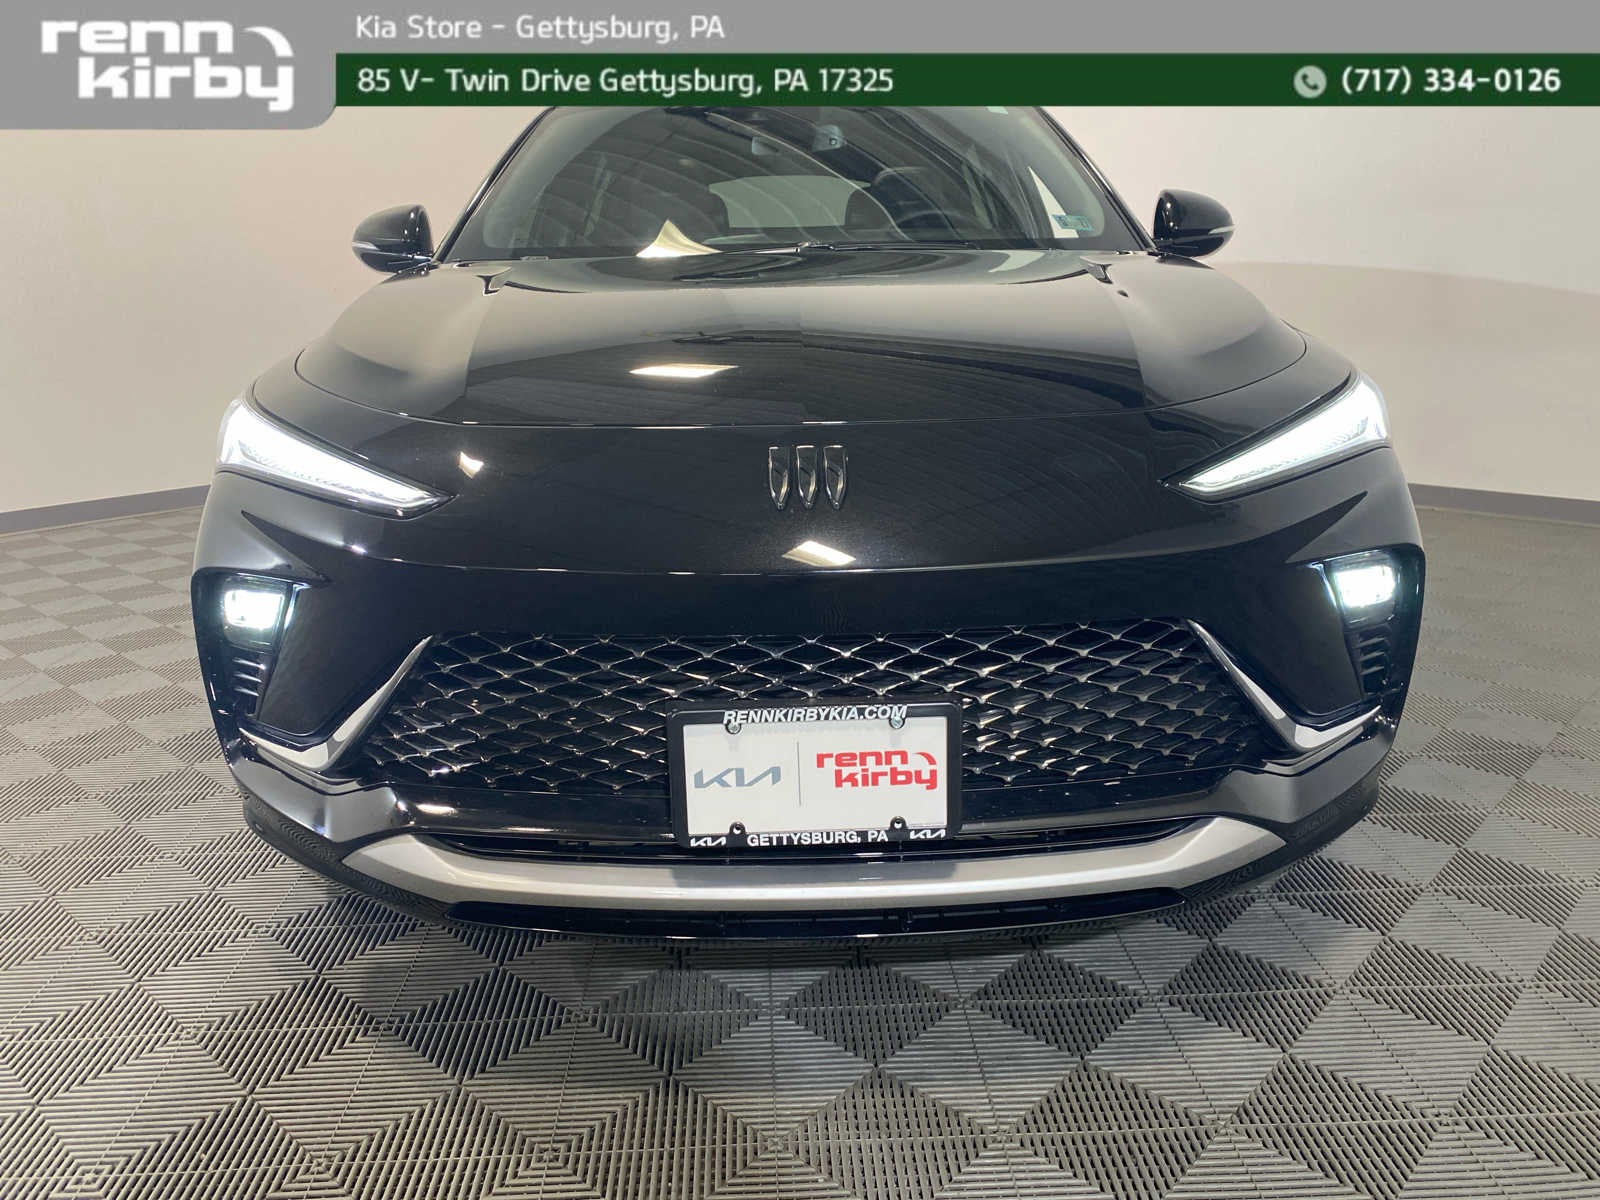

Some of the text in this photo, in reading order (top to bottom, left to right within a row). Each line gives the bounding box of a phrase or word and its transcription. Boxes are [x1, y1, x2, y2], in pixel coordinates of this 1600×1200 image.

[723, 705, 907, 725] RENNKIRBYKIA.COM
[816, 750, 908, 768] renn
[834, 764, 938, 790] kirby
[747, 829, 889, 847] GETTYSBURG, PA
